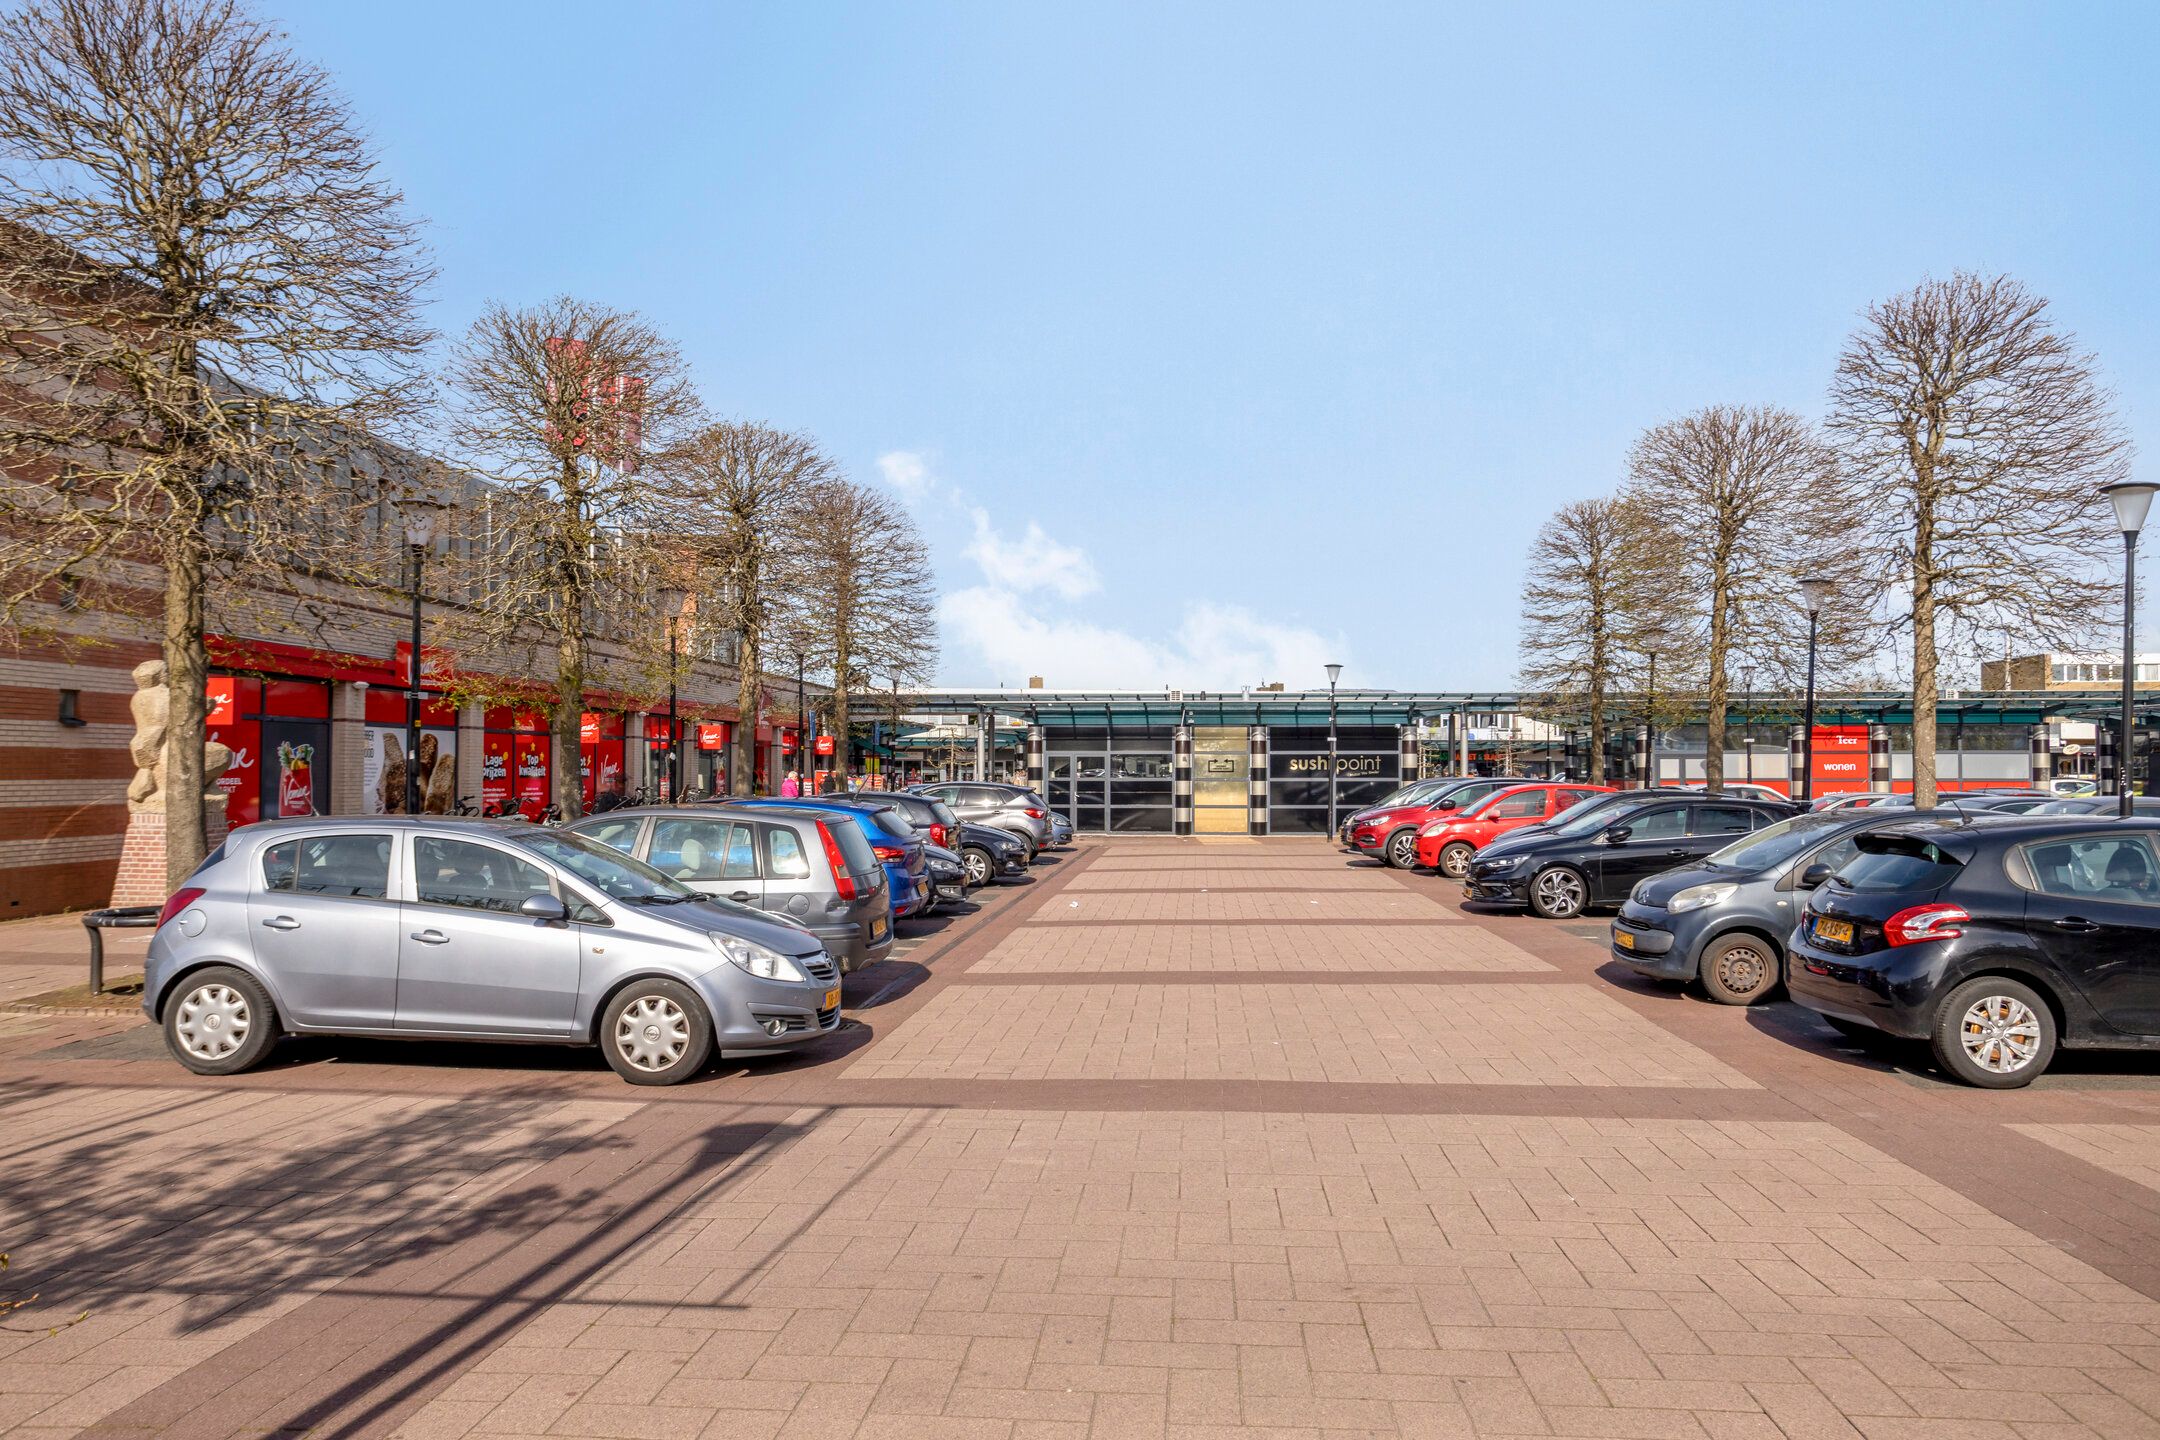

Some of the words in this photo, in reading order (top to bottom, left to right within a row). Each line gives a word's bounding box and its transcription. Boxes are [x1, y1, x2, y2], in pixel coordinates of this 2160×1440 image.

[1836, 735, 1857, 744] Teer
[485, 754, 503, 767] Lage
[526, 754, 539, 765] Top
[1336, 755, 1382, 775] point
[518, 765, 546, 777] kwaliteit
[1823, 763, 1856, 771] wonen
